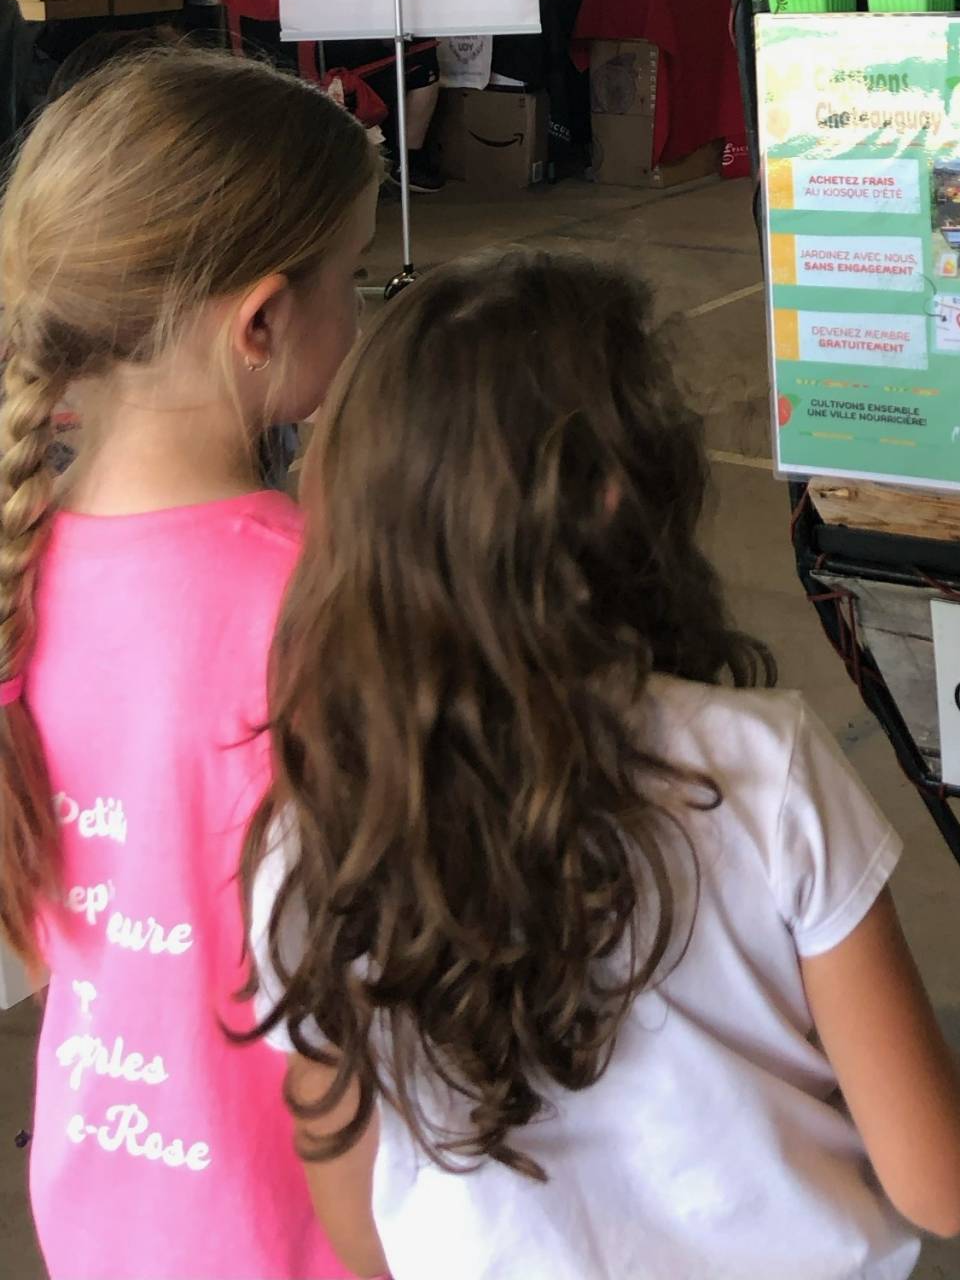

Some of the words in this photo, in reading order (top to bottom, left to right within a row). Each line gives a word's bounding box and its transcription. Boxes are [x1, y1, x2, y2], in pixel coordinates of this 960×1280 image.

[809, 175, 860, 185] ACHETEZ
[862, 177, 895, 186] FRAIS
[804, 187, 820, 196] AU
[823, 188, 869, 198] KIOSQUE
[872, 188, 903, 199] D'ÉTÉ
[800, 249, 850, 260] JARDINEZ
[853, 252, 881, 261] AVEC
[884, 254, 918, 265] NOUS,
[804, 261, 834, 271] SANS
[838, 263, 914, 275] ENGAGEMENT
[811, 326, 861, 338] DEVENEZ
[864, 330, 911, 341] MEMBRE
[818, 339, 904, 352] GRATUITEMENT
[810, 398, 865, 411] CULTIVONS
[868, 403, 920, 416] ENSEMBLE
[807, 408, 829, 417] UNE
[830, 411, 857, 420] VILLE
